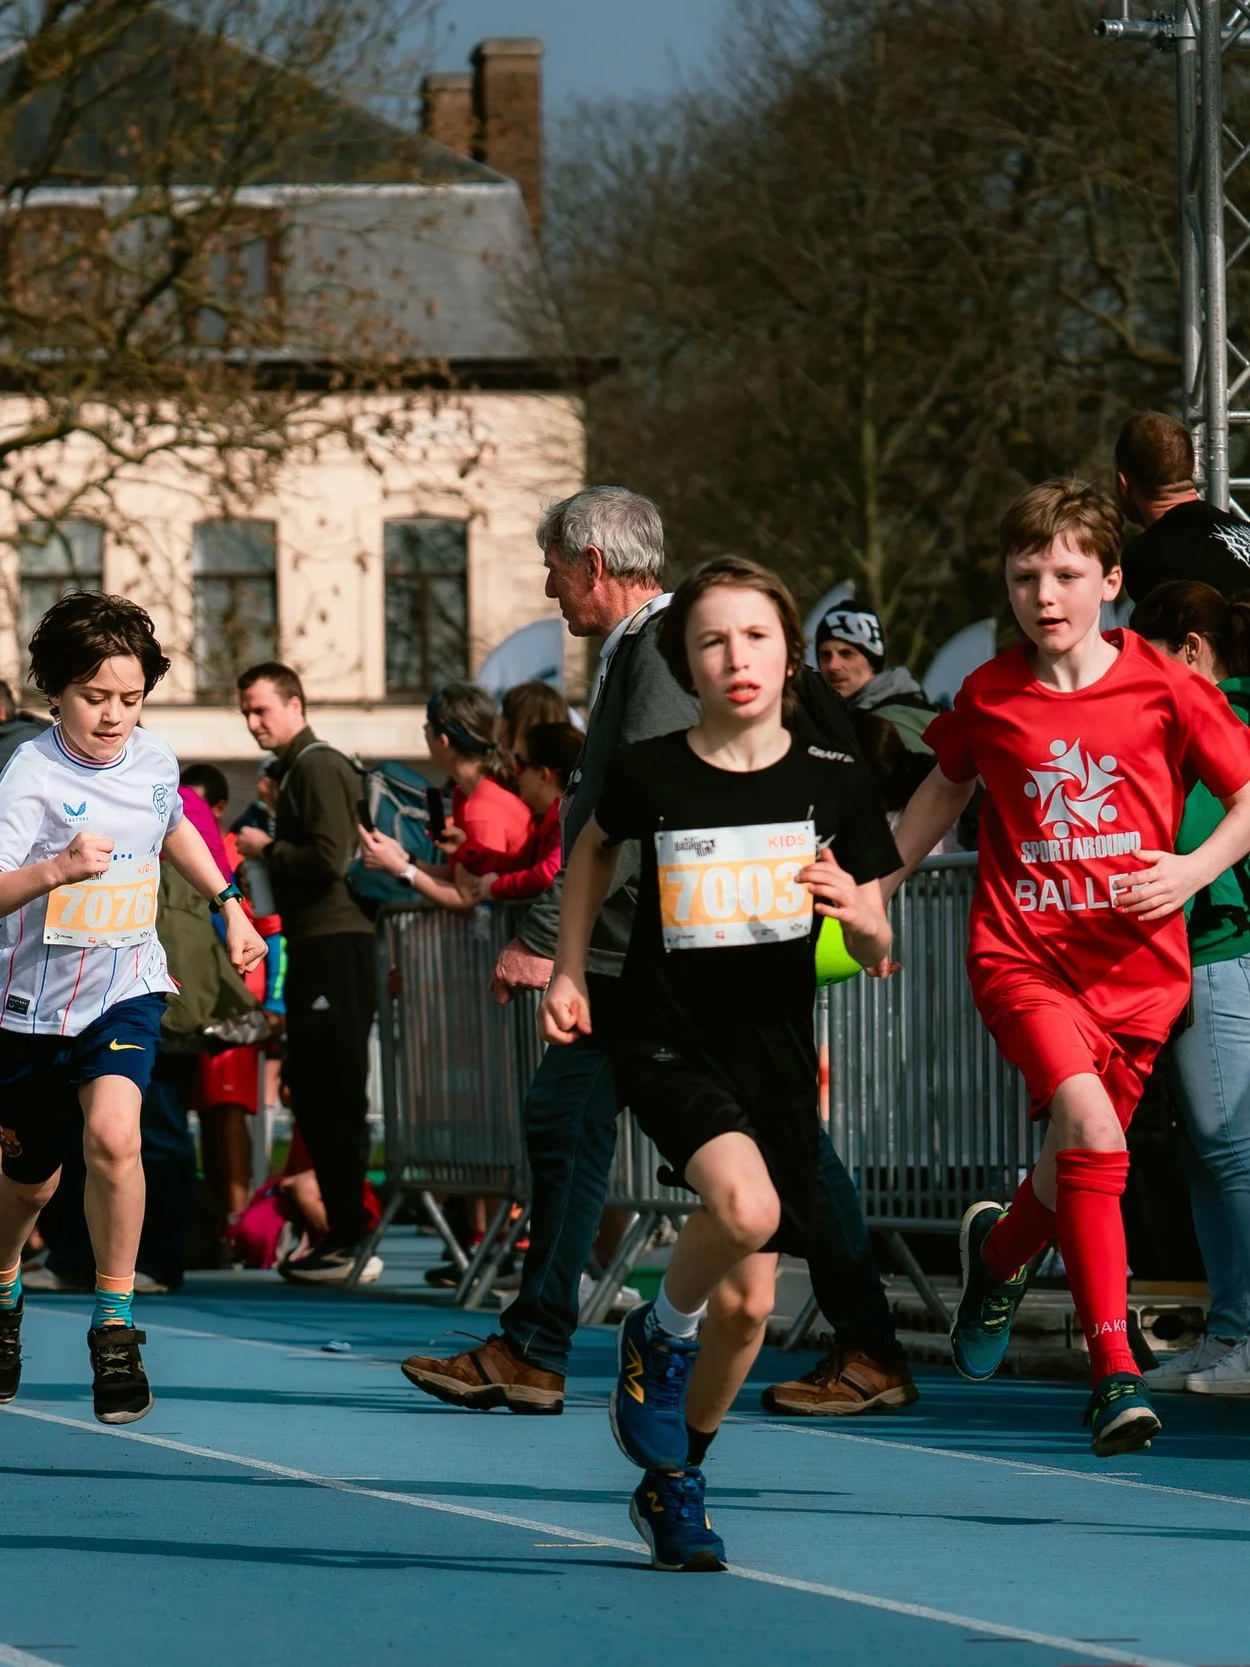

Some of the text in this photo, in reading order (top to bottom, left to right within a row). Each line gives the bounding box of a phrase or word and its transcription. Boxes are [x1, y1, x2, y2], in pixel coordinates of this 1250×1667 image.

[767, 834, 806, 848] KIDS
[1021, 831, 1142, 864] SPORTAROUND
[59, 884, 152, 929] 7076
[667, 861, 805, 921] 7003
[1015, 871, 1152, 912] BALLE
[1092, 1319, 1127, 1338] JAKO
